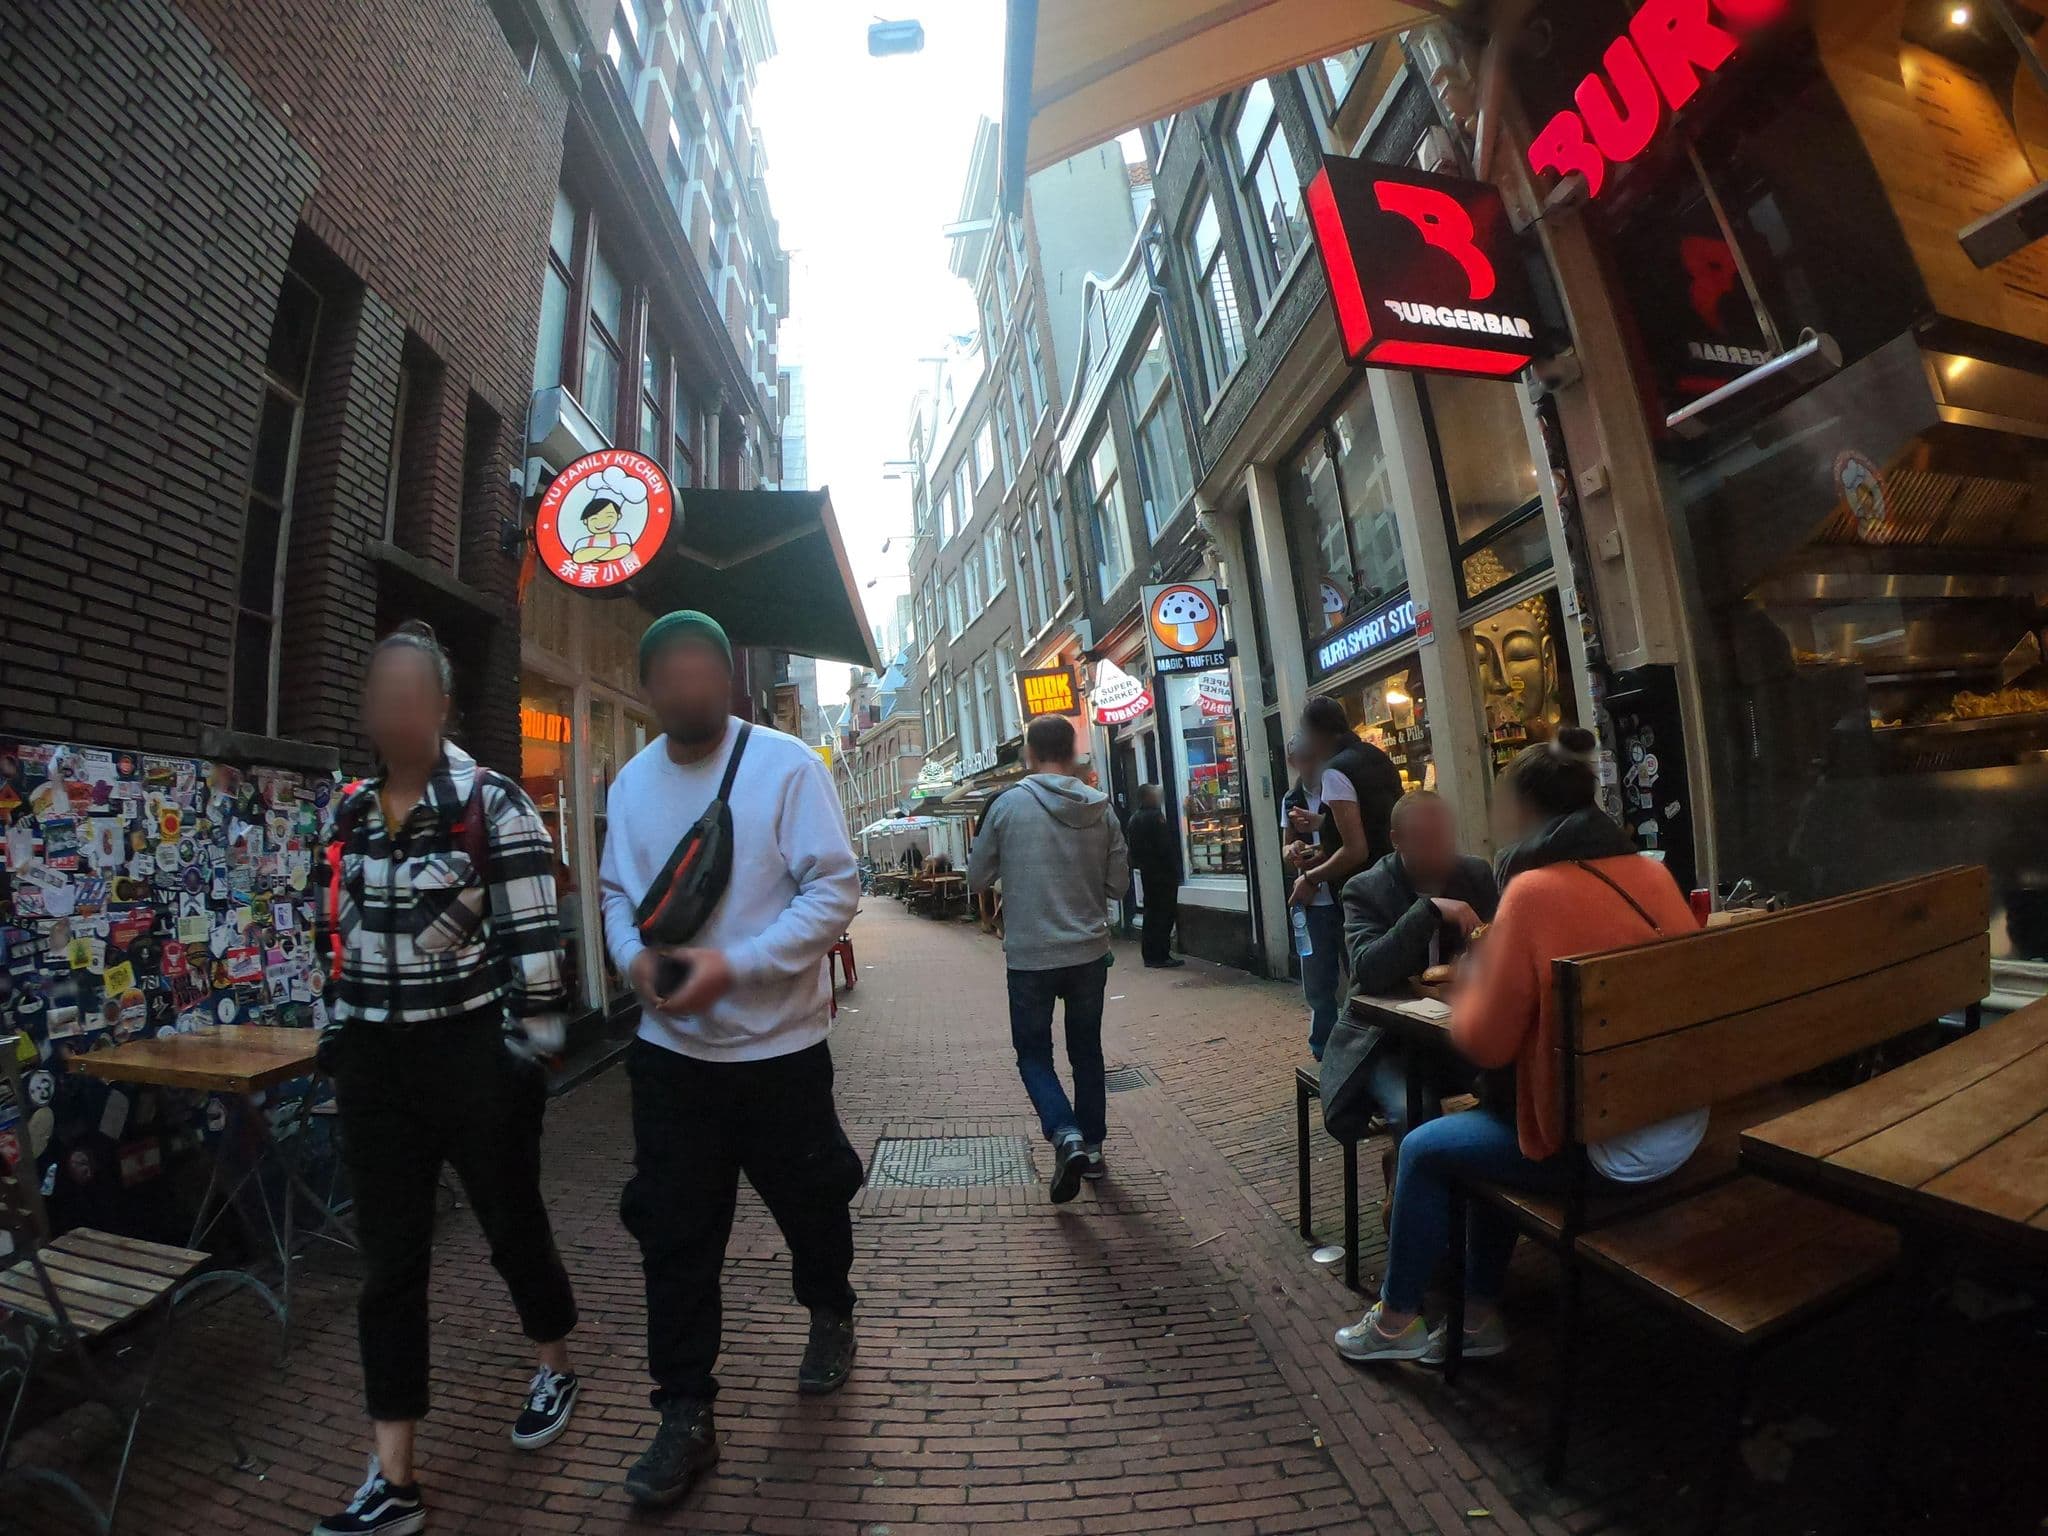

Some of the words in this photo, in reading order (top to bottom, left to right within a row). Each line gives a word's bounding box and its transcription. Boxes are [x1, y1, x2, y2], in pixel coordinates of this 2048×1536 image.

[1384, 300, 1533, 339] BURGERBAR
[544, 487, 562, 507] YU
[559, 453, 611, 487] FAMILY
[615, 453, 665, 495] KITCHEN
[1347, 615, 1387, 655] SMART
[1156, 657, 1184, 672] MAGIC
[1185, 653, 1225, 668] TRUFFLES
[1024, 673, 1072, 701] WOK
[1100, 687, 1139, 705] MARKET
[1101, 680, 1133, 696] SUPER
[1104, 695, 1149, 722] TOBACCO
